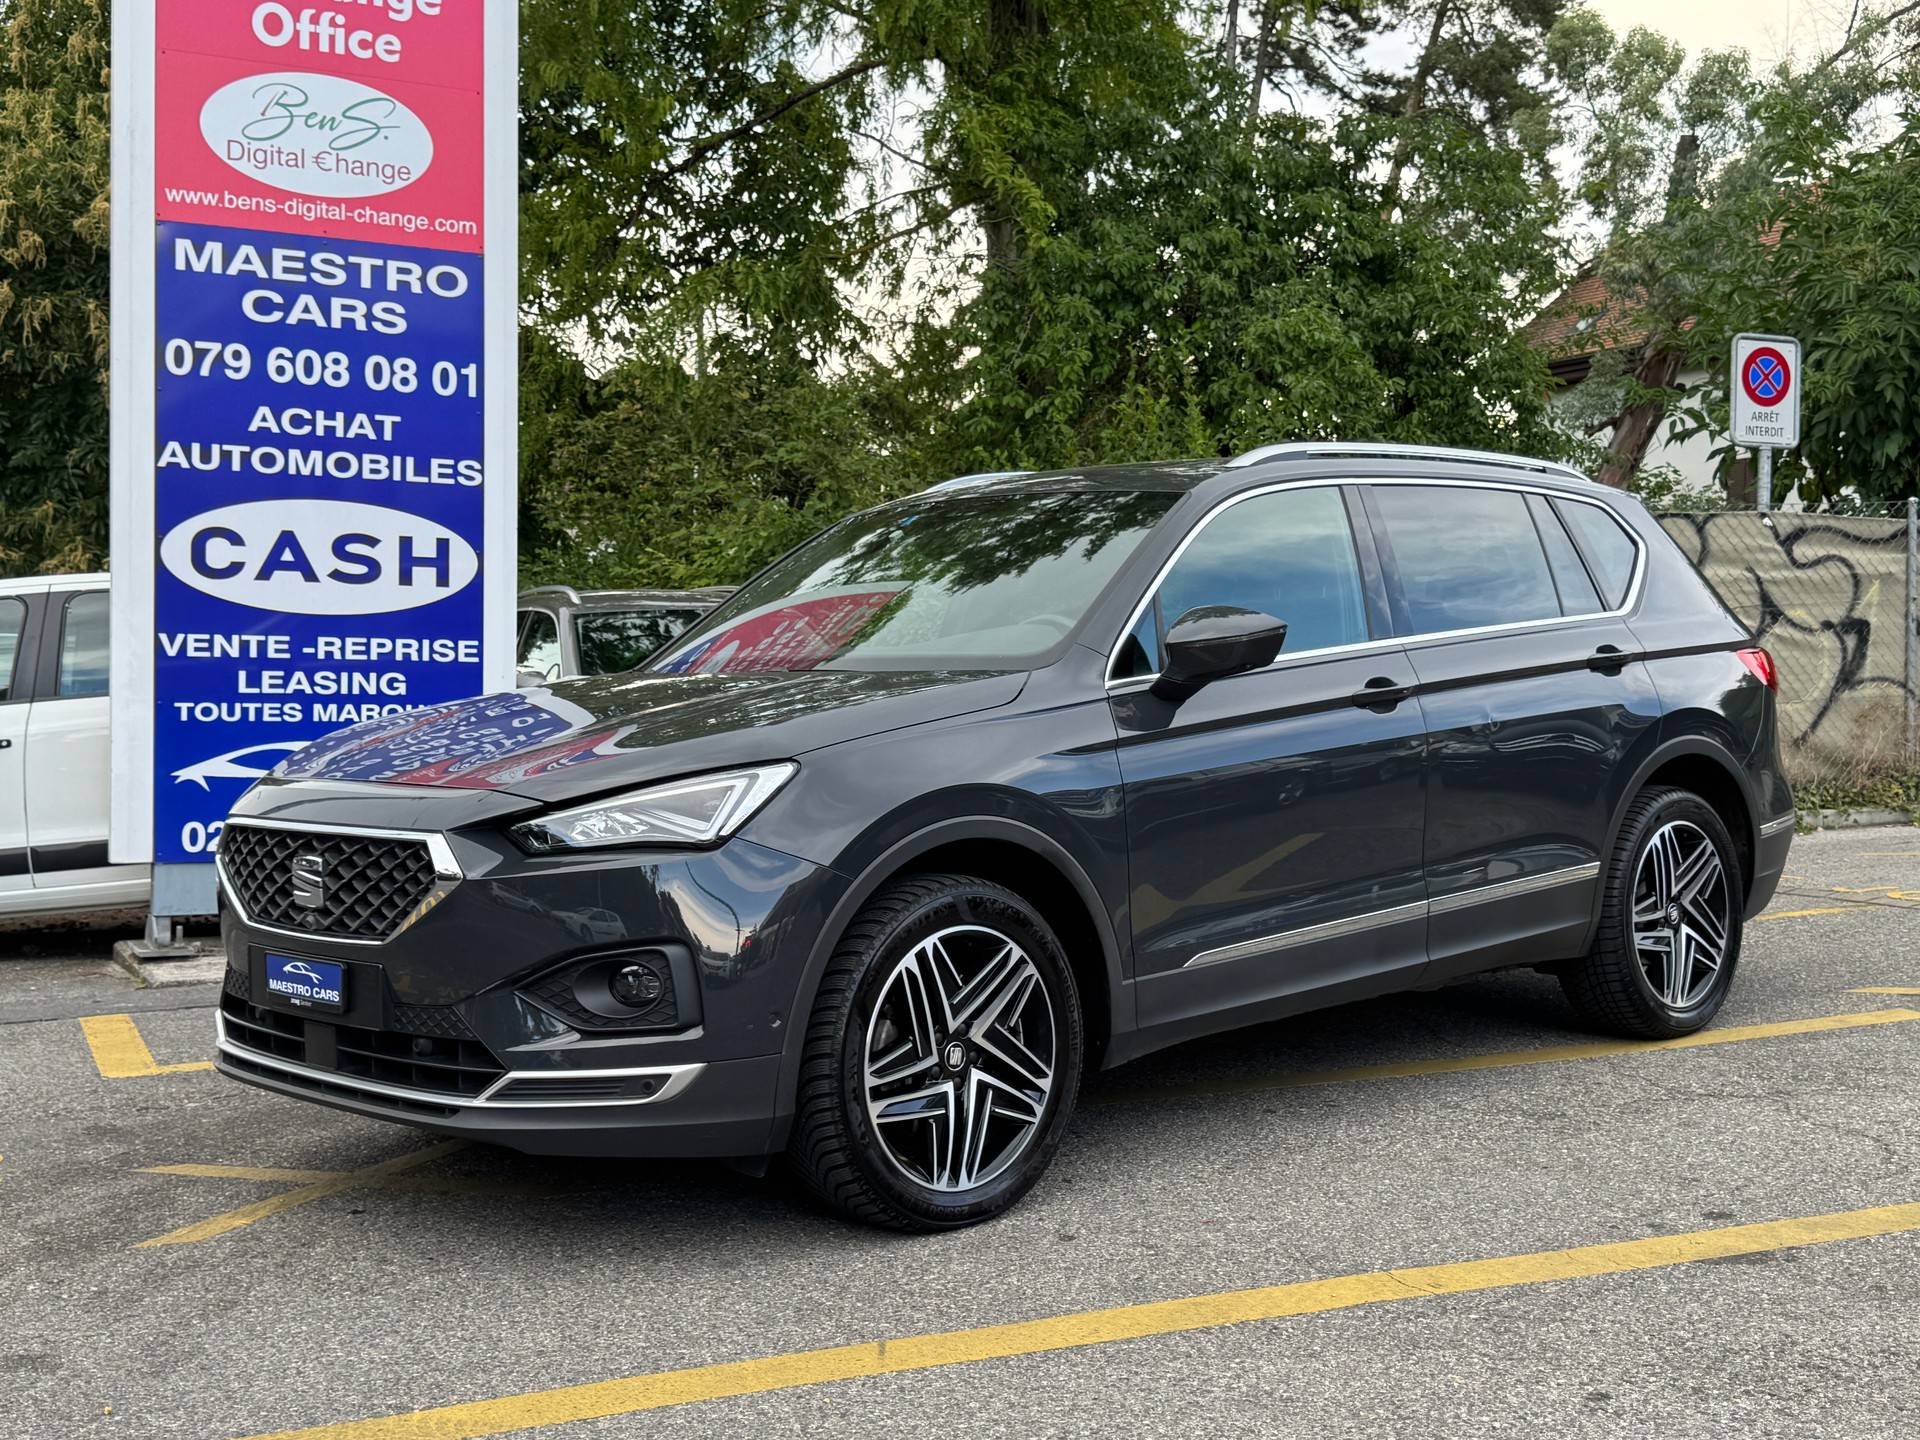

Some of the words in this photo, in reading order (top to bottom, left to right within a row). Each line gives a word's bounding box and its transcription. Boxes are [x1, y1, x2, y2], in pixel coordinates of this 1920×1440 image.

[252, 2, 402, 63] Office
[226, 139, 306, 170] Digital
[312, 150, 412, 185] €hange
[165, 186, 478, 236] www.bens-digital-change.com
[174, 238, 469, 298] MAESTRO
[241, 289, 408, 335] CARS
[164, 338, 252, 380] 079
[267, 346, 350, 388] 608
[365, 354, 418, 394] 08
[432, 361, 478, 398] 01
[248, 406, 402, 442] ACHAT
[1745, 425, 1785, 437] INTERDIT
[1751, 410, 1780, 423] ARRÊT
[157, 441, 484, 487] AUTOMOBILES
[190, 526, 451, 588] CASH
[158, 633, 291, 660] VENTE
[302, 636, 480, 663] -REPRISE
[238, 670, 408, 696] LEASING
[174, 702, 303, 723] TOUTES
[269, 978, 311, 997] MAESTRO
[312, 987, 340, 1002] CARS
